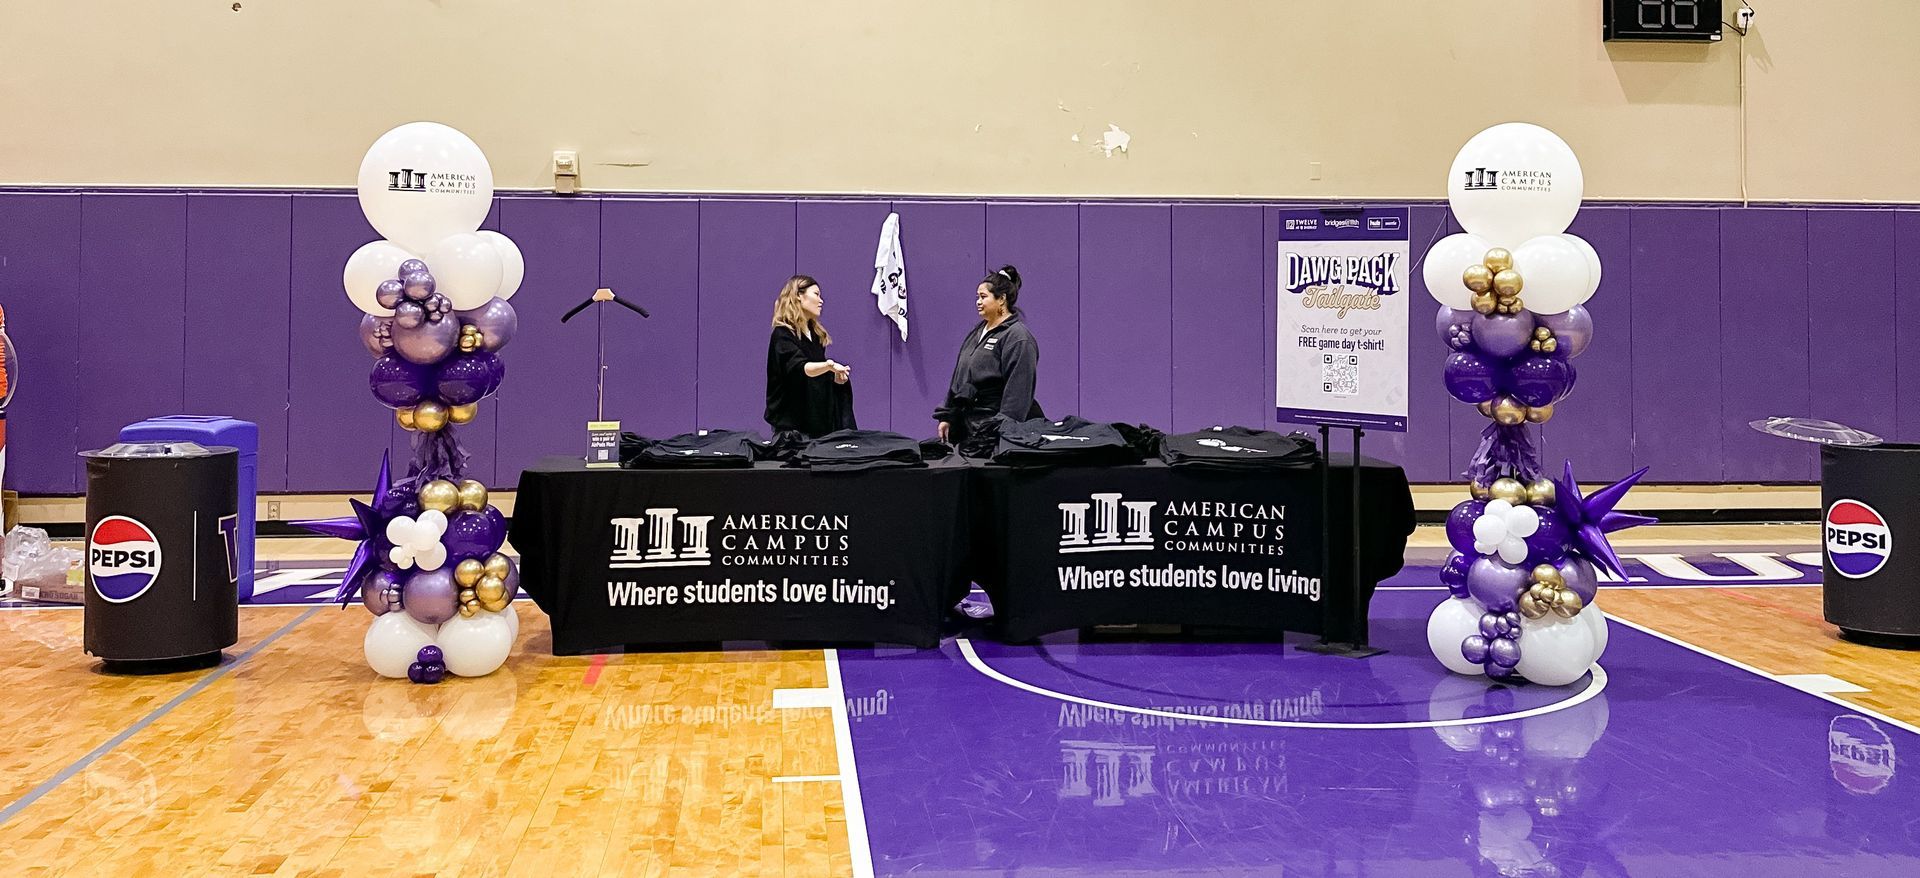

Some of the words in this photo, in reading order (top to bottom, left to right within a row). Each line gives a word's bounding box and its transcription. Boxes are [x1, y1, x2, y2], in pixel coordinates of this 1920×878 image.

[430, 173, 476, 181] AMERICAN
[430, 180, 476, 189] CAMPUS
[1502, 178, 1552, 186] CAMPUS
[1286, 252, 1342, 292] DAWG
[1346, 252, 1400, 293] PACK
[1302, 285, 1381, 319] Tailgate
[1301, 325, 1320, 334] Scan
[1322, 325, 1338, 334] here
[1350, 327, 1362, 336] get
[1298, 336, 1317, 348] FREE
[1319, 339, 1340, 350] game
[1342, 338, 1355, 352] day
[1358, 339, 1384, 351] t-shirt!
[1164, 501, 1286, 520] AMERICAN
[722, 514, 849, 531] AMERICAN
[1164, 520, 1284, 541] CAMPUS
[722, 535, 849, 551] CAMPUS
[1828, 527, 1886, 549] PEPSI
[1164, 540, 1284, 556] COMMUNITIES
[92, 548, 155, 568] PEPSI
[722, 555, 849, 566] COMMUNITIES
[1058, 566, 1125, 591] Where
[1130, 564, 1216, 589] students
[1222, 565, 1263, 591] love
[1268, 568, 1321, 602] living
[608, 581, 678, 606] Where
[683, 579, 777, 604] students
[783, 578, 827, 603] love
